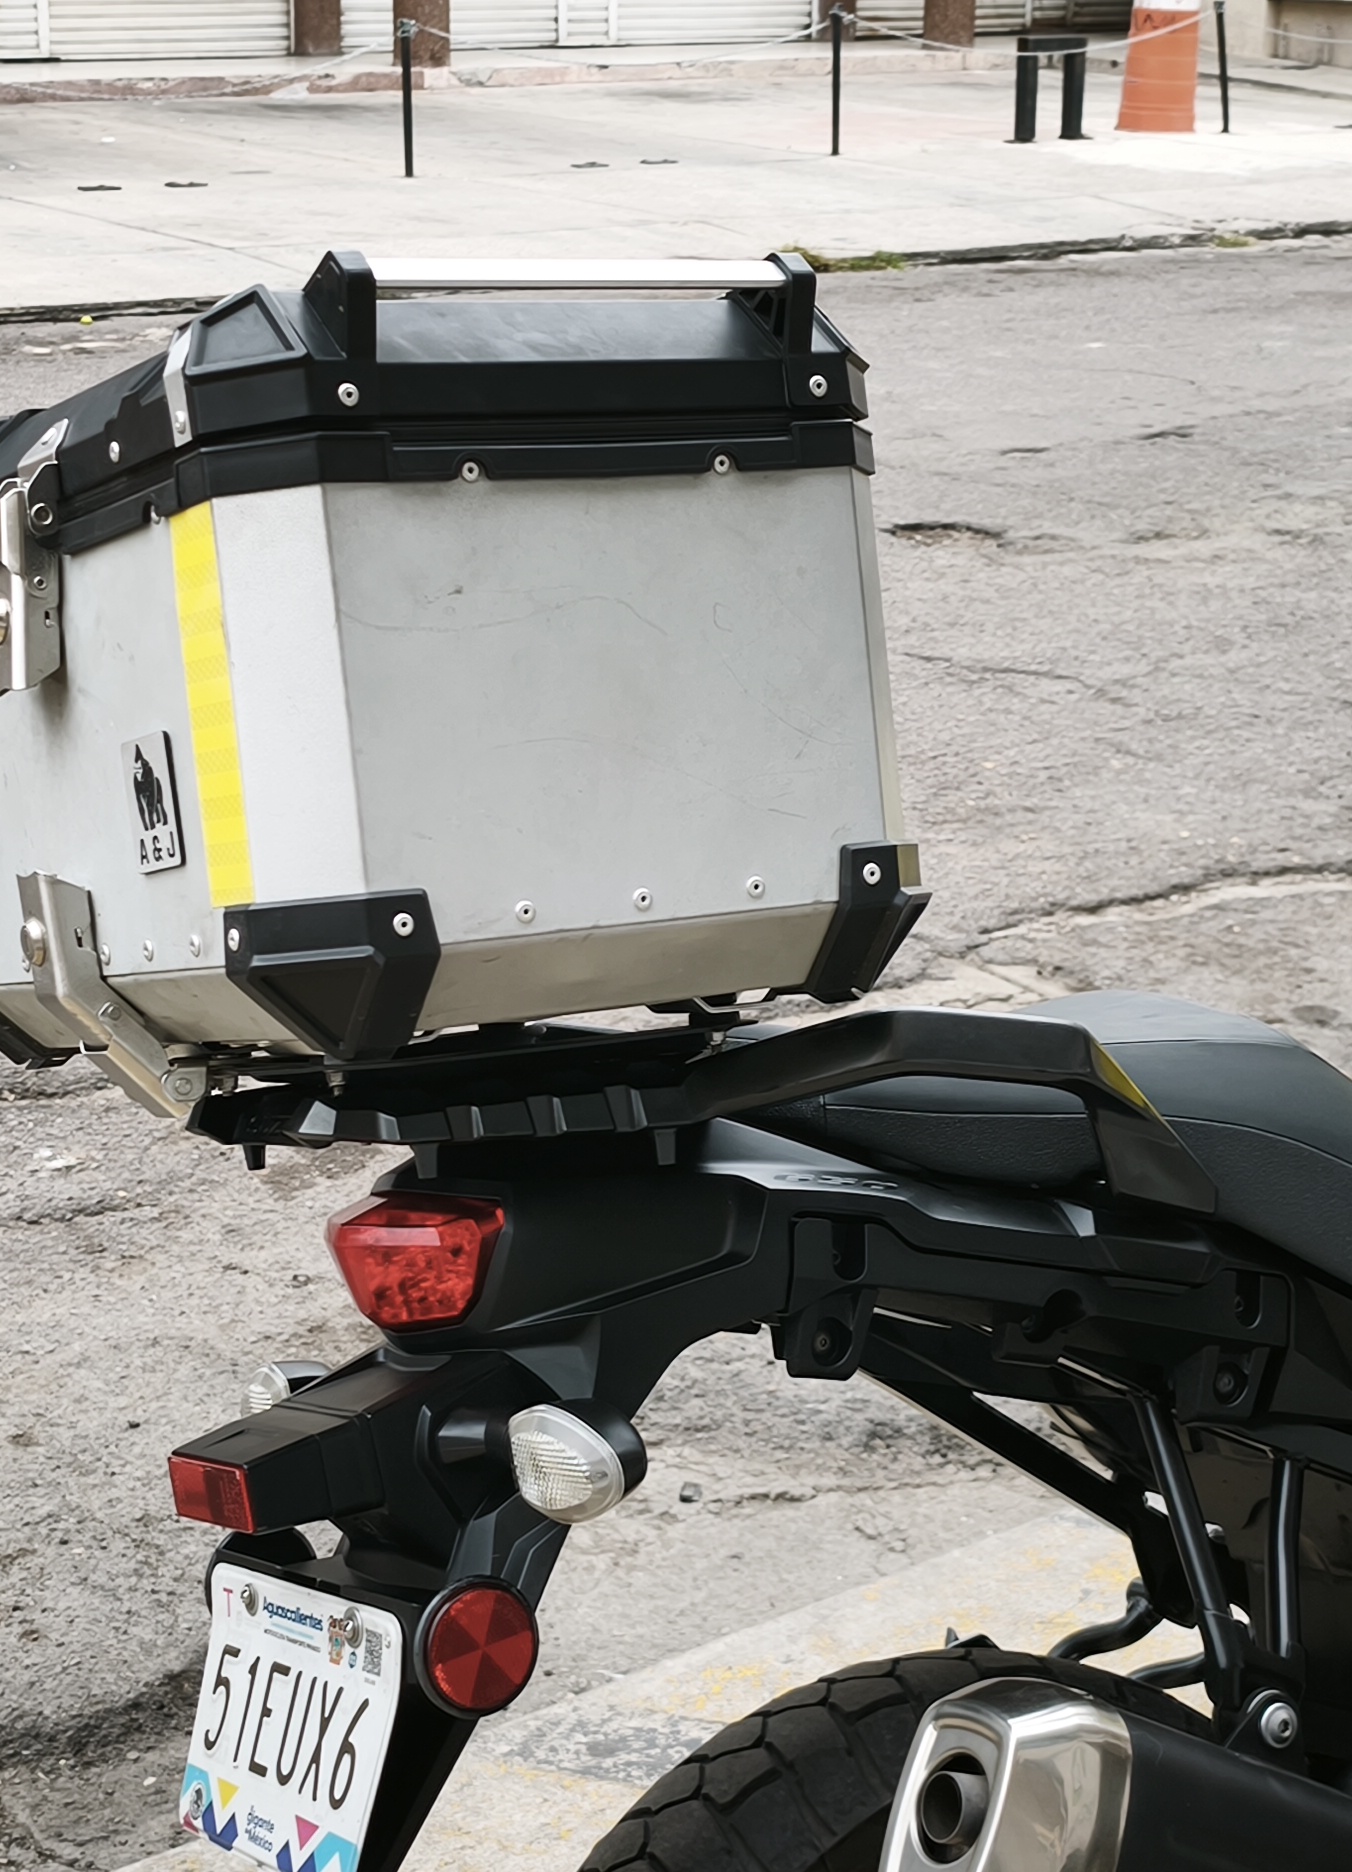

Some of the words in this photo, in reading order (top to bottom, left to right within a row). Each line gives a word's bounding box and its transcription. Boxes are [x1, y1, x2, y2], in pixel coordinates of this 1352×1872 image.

[139, 838, 150, 865] A
[152, 834, 164, 862] &
[166, 830, 176, 858] J
[204, 1644, 370, 1811] 51EUX6
